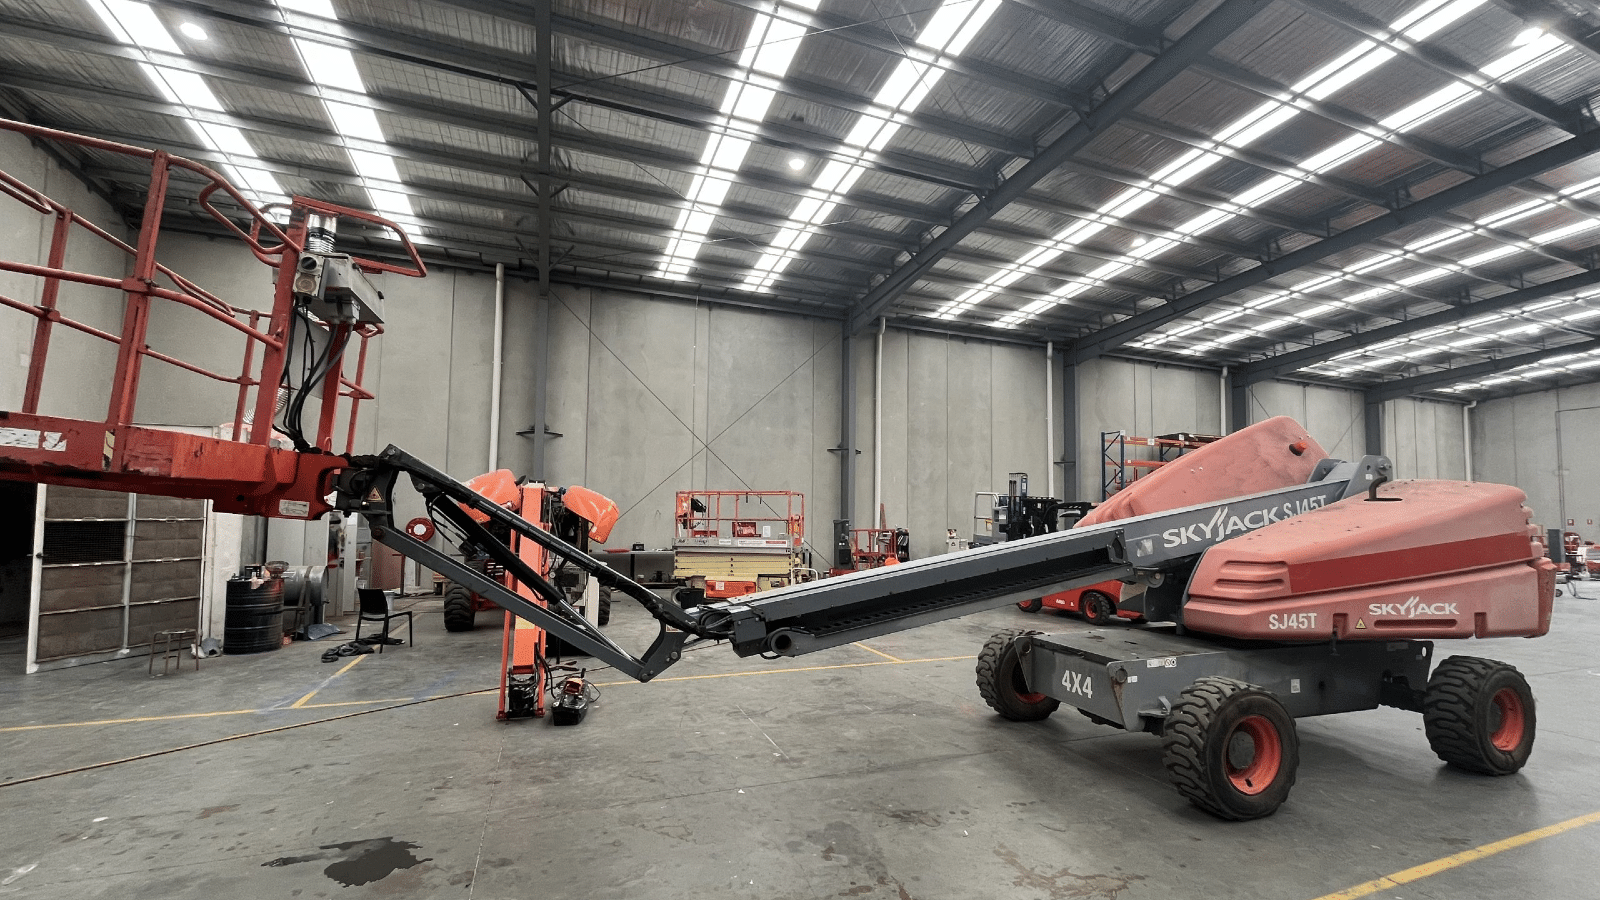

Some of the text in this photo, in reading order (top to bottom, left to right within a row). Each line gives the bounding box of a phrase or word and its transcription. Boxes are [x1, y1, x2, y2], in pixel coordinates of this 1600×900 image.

[1162, 494, 1326, 548] SKYJACK SJ45T
[1368, 596, 1459, 618] SKYJACK
[1269, 612, 1317, 630] SJ45T
[1061, 670, 1093, 698] 4X4
